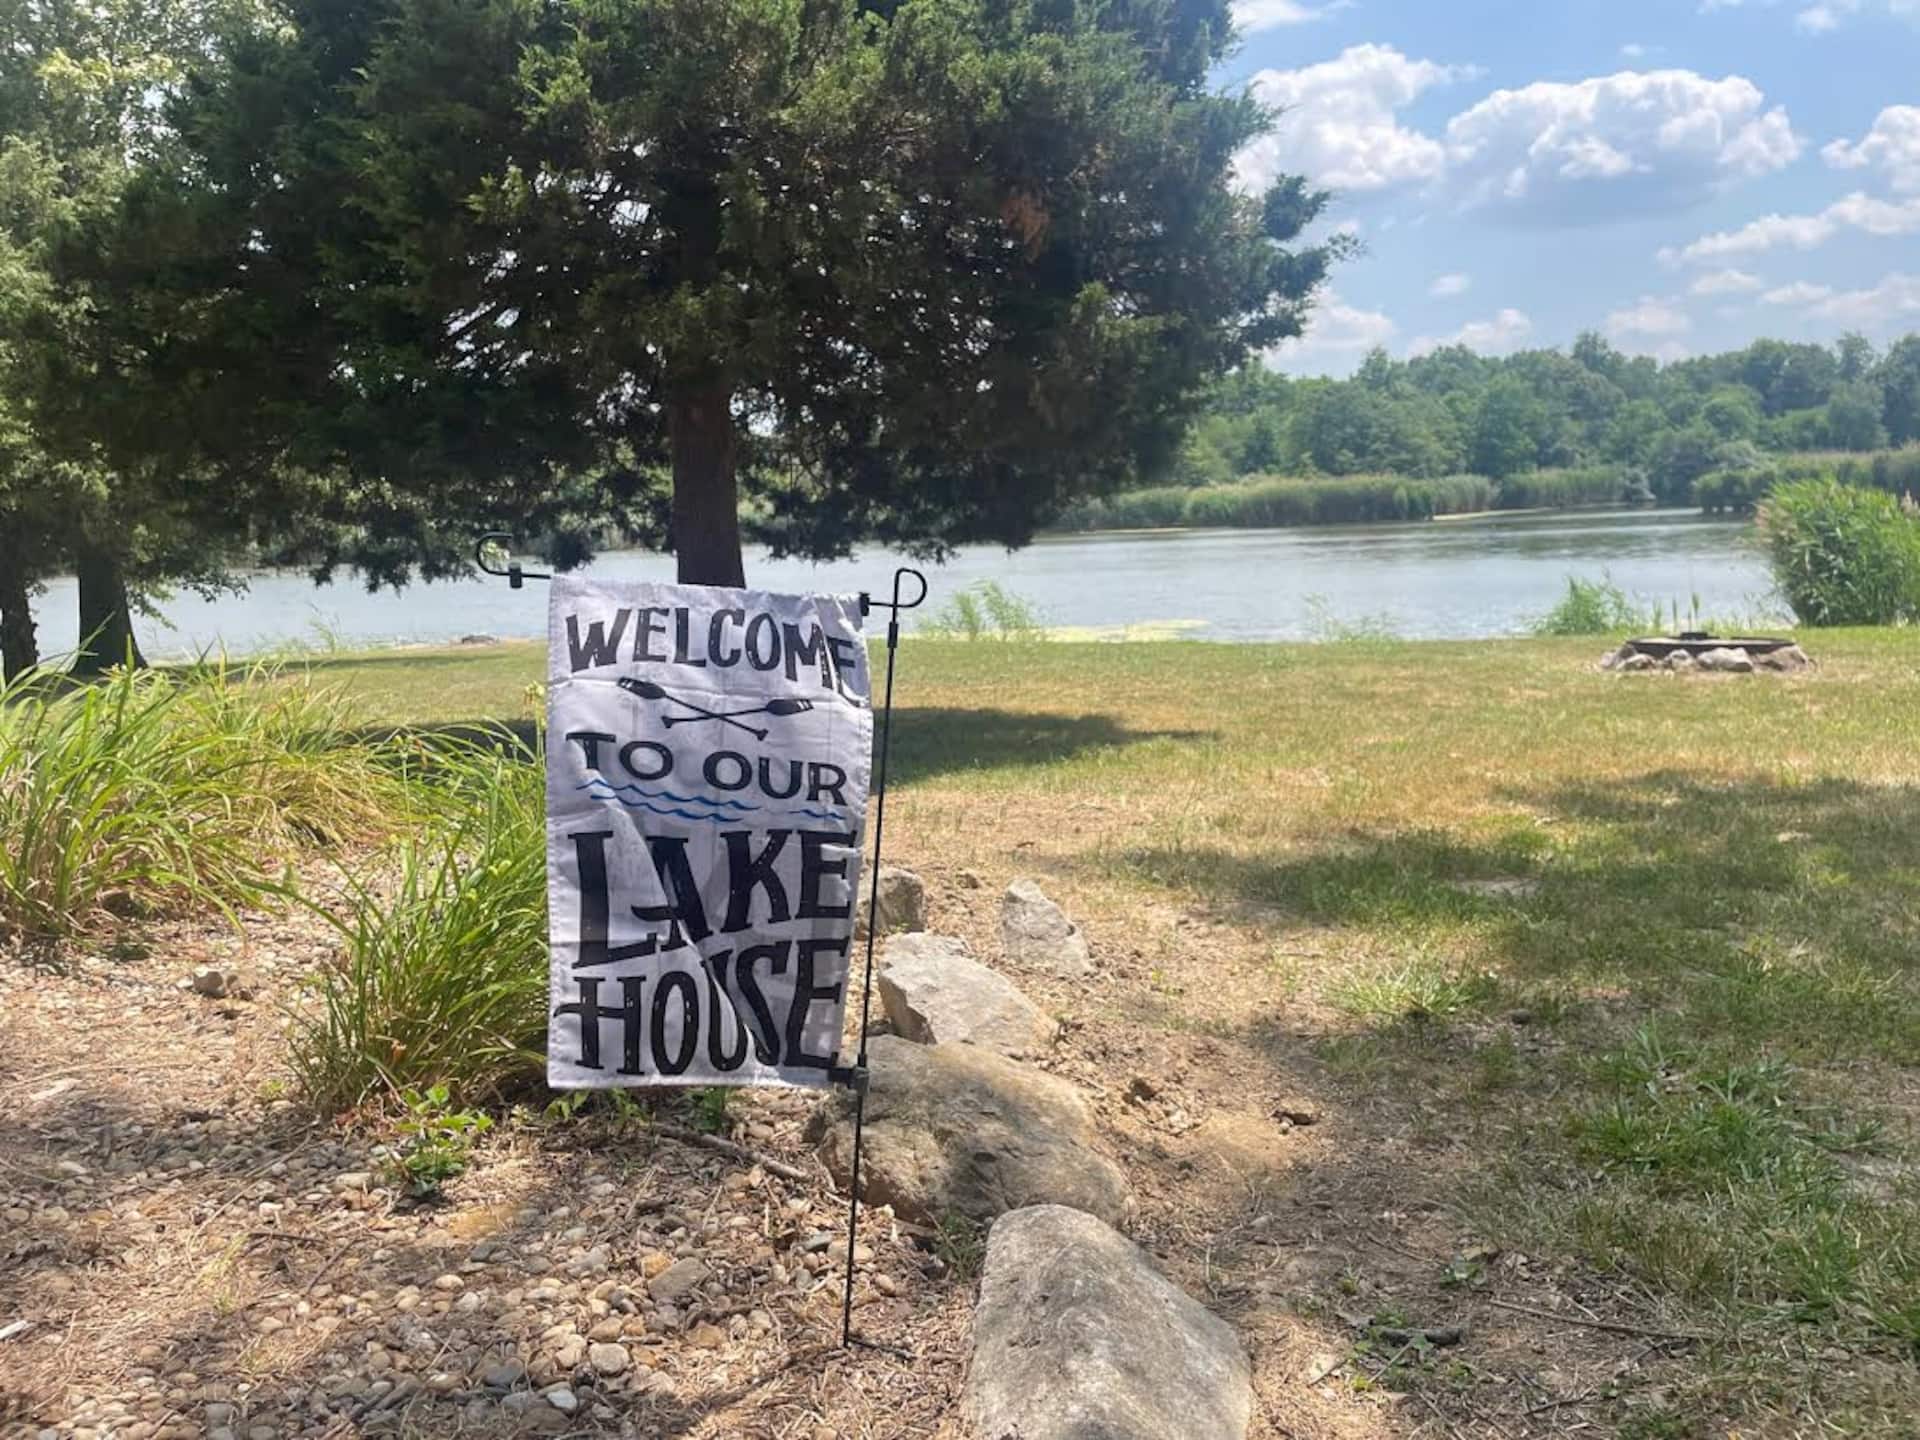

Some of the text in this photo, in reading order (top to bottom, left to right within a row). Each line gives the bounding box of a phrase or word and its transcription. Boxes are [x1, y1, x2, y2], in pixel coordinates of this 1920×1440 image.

[566, 607, 862, 707] WELCOME
[566, 732, 847, 806] TO OUR
[568, 829, 857, 969] LAKE
[553, 935, 850, 1075] HOUSE
